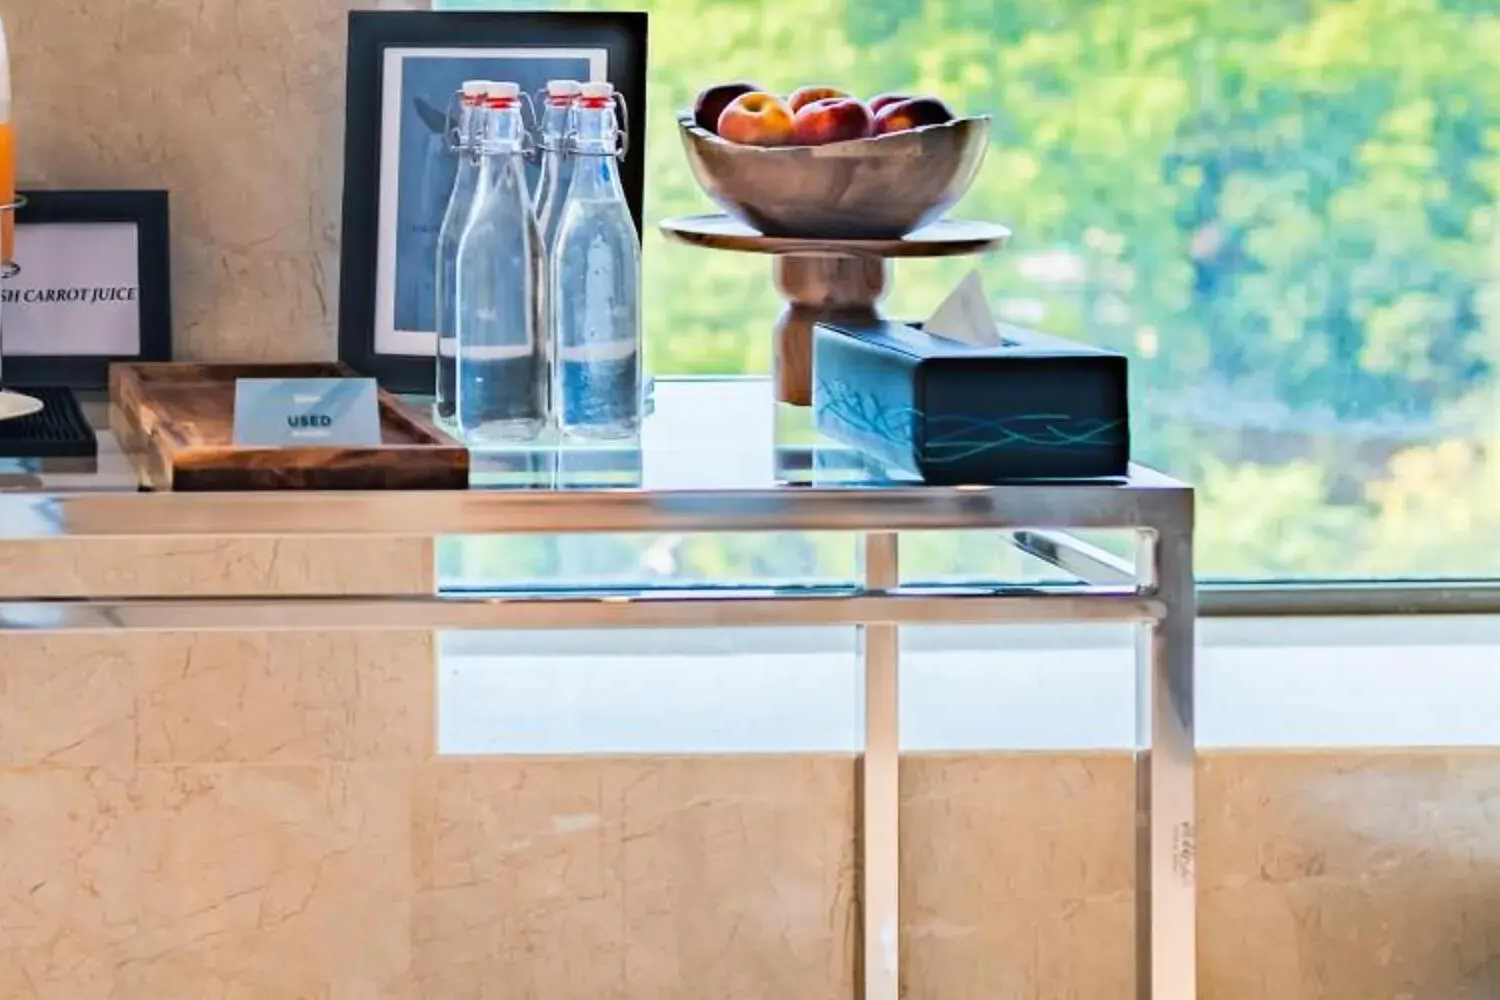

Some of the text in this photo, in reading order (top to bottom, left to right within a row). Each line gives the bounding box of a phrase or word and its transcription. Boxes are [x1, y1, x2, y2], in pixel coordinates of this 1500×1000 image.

[23, 287, 90, 303] CARROT
[91, 286, 137, 304] JUICE
[287, 414, 332, 428] USED
